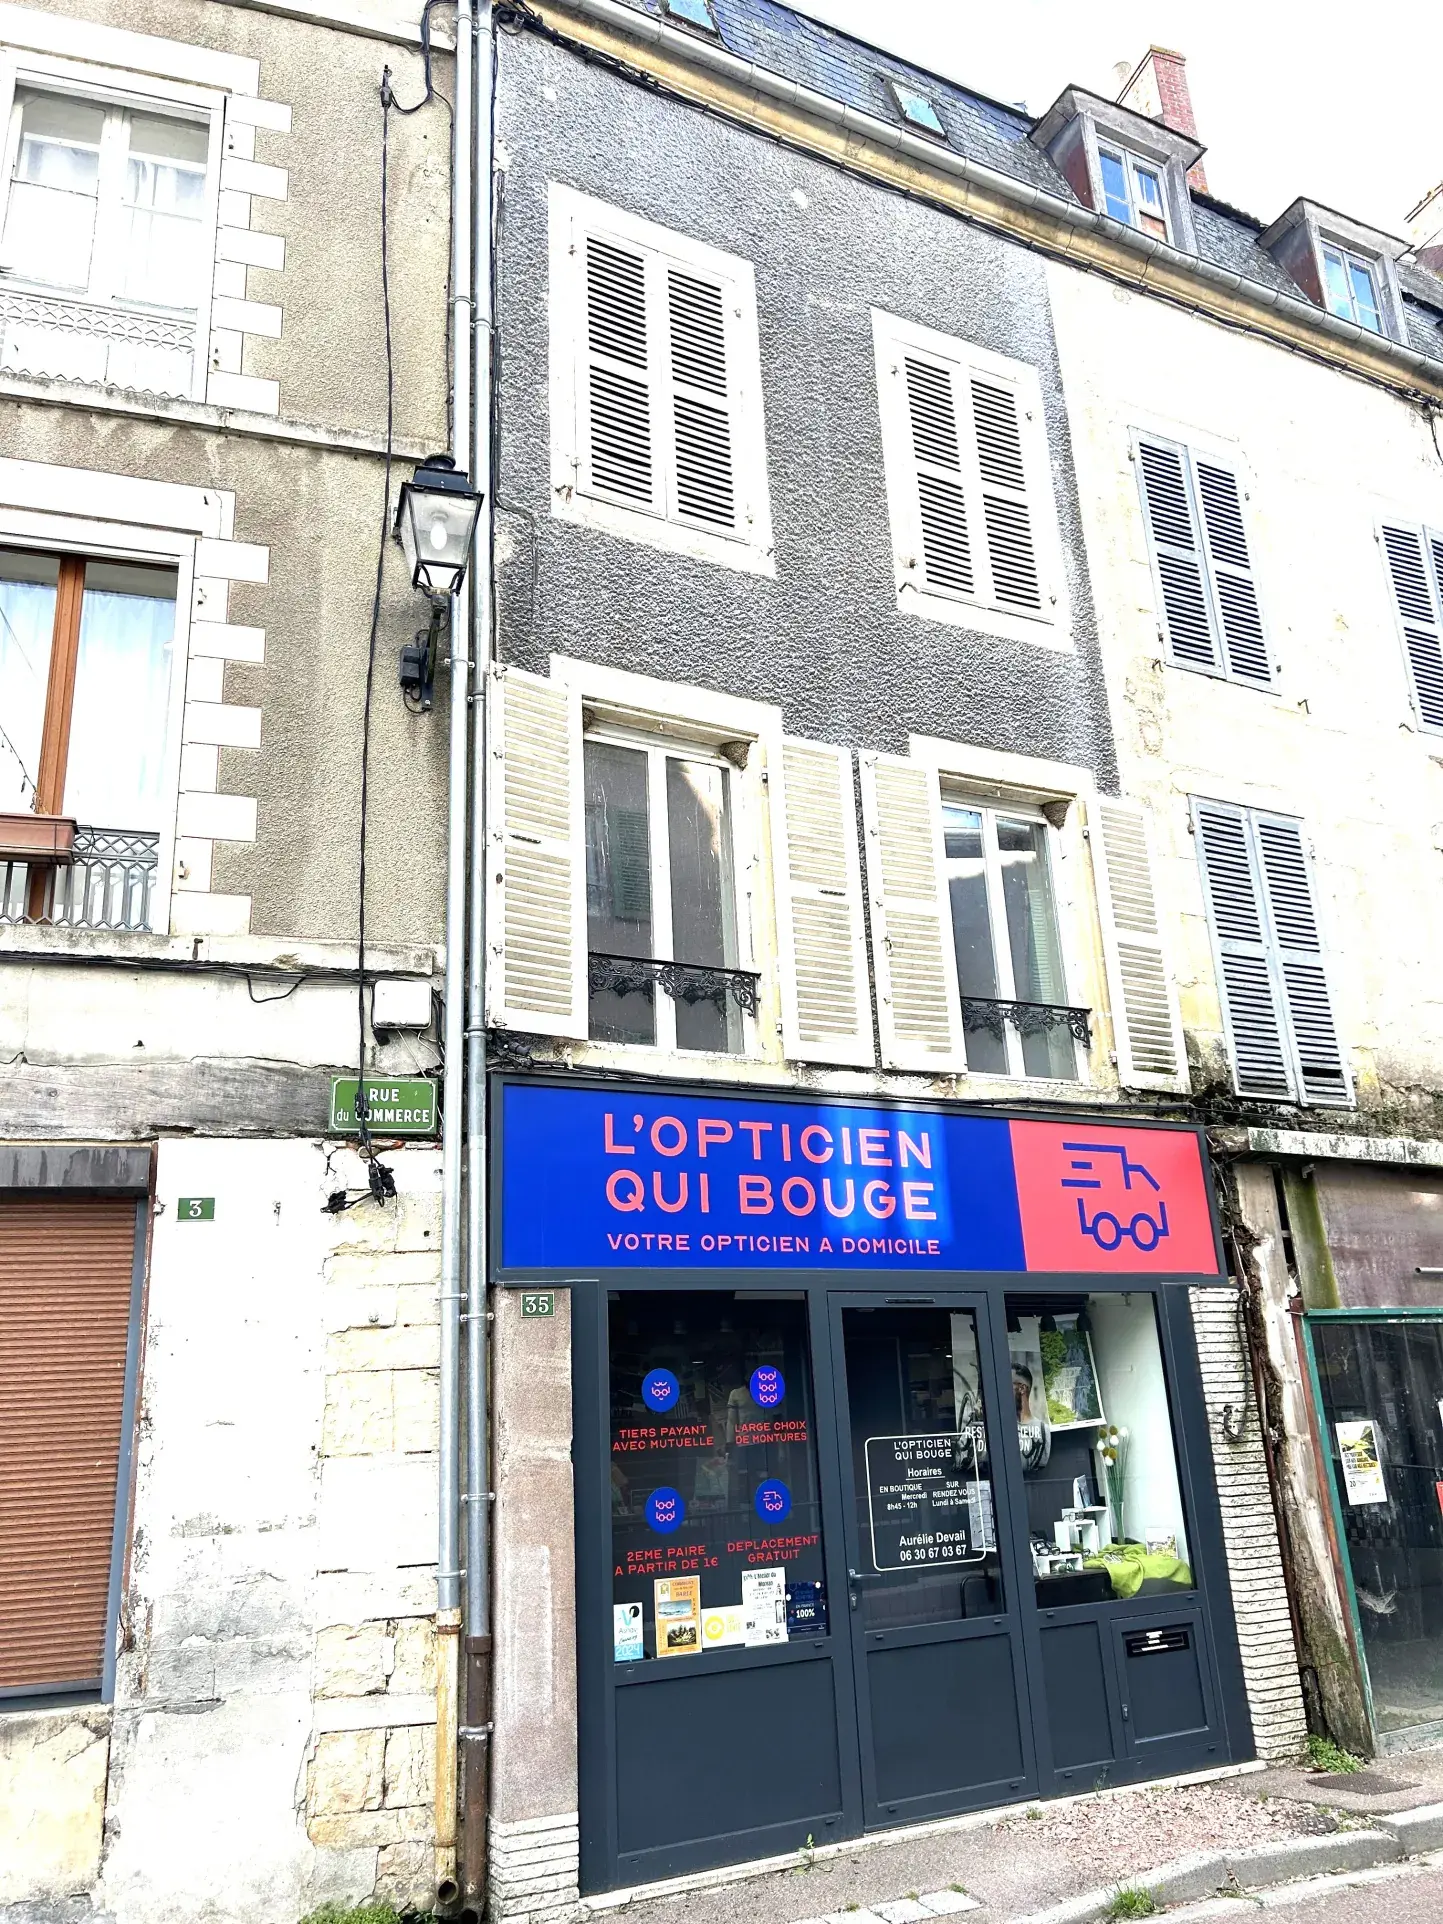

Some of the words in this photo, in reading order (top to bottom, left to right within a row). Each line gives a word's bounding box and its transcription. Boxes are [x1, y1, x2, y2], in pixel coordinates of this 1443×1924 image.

[370, 1088, 400, 1102] RUE
[336, 1108, 349, 1121] du
[604, 1112, 932, 1169] L'OPTICIEN
[605, 1170, 710, 1213] QUI
[739, 1174, 937, 1220] BOUGE
[189, 1200, 202, 1217] 3
[607, 1233, 690, 1251] VOTRE
[700, 1235, 810, 1253] OPTICIEN
[819, 1237, 833, 1253] A
[842, 1238, 940, 1255] DOMICILE
[526, 1296, 549, 1313] 35
[619, 1428, 656, 1439] TIERS
[660, 1425, 707, 1436] PAYANT
[735, 1422, 770, 1433] LARGE
[774, 1421, 806, 1431] CHOIX
[612, 1439, 646, 1451] AVEC
[650, 1436, 714, 1448] MUTUELLE
[735, 1434, 749, 1444] DE
[752, 1432, 807, 1444] MONTURES
[894, 1438, 951, 1450] L'OPTICIEN
[895, 1451, 913, 1460] QUI
[916, 1449, 952, 1459] BOUGE
[908, 1467, 942, 1477] Horaires
[890, 1484, 922, 1493] BOUTIQUE
[932, 1490, 957, 1498] RENDEZ
[902, 1492, 927, 1500] Mercredi
[932, 1498, 948, 1507] Lundi
[728, 1535, 819, 1553] DEPLACEMENT
[899, 1532, 934, 1546] Aurélie
[936, 1530, 966, 1543] Devail
[627, 1549, 664, 1562] 2EME
[668, 1545, 706, 1558] PAIRE
[748, 1550, 800, 1563] GRATUIT
[900, 1549, 912, 1561] 06
[914, 1548, 926, 1560] 30
[929, 1547, 940, 1558] 67
[942, 1546, 953, 1557] 03
[956, 1545, 967, 1555] 67
[615, 1564, 623, 1576] A
[628, 1560, 676, 1574] PARTIR
[681, 1559, 697, 1570] DE
[703, 1557, 719, 1568] 1€
[796, 1608, 815, 1618] 100%
[616, 1644, 640, 1656] 2024
